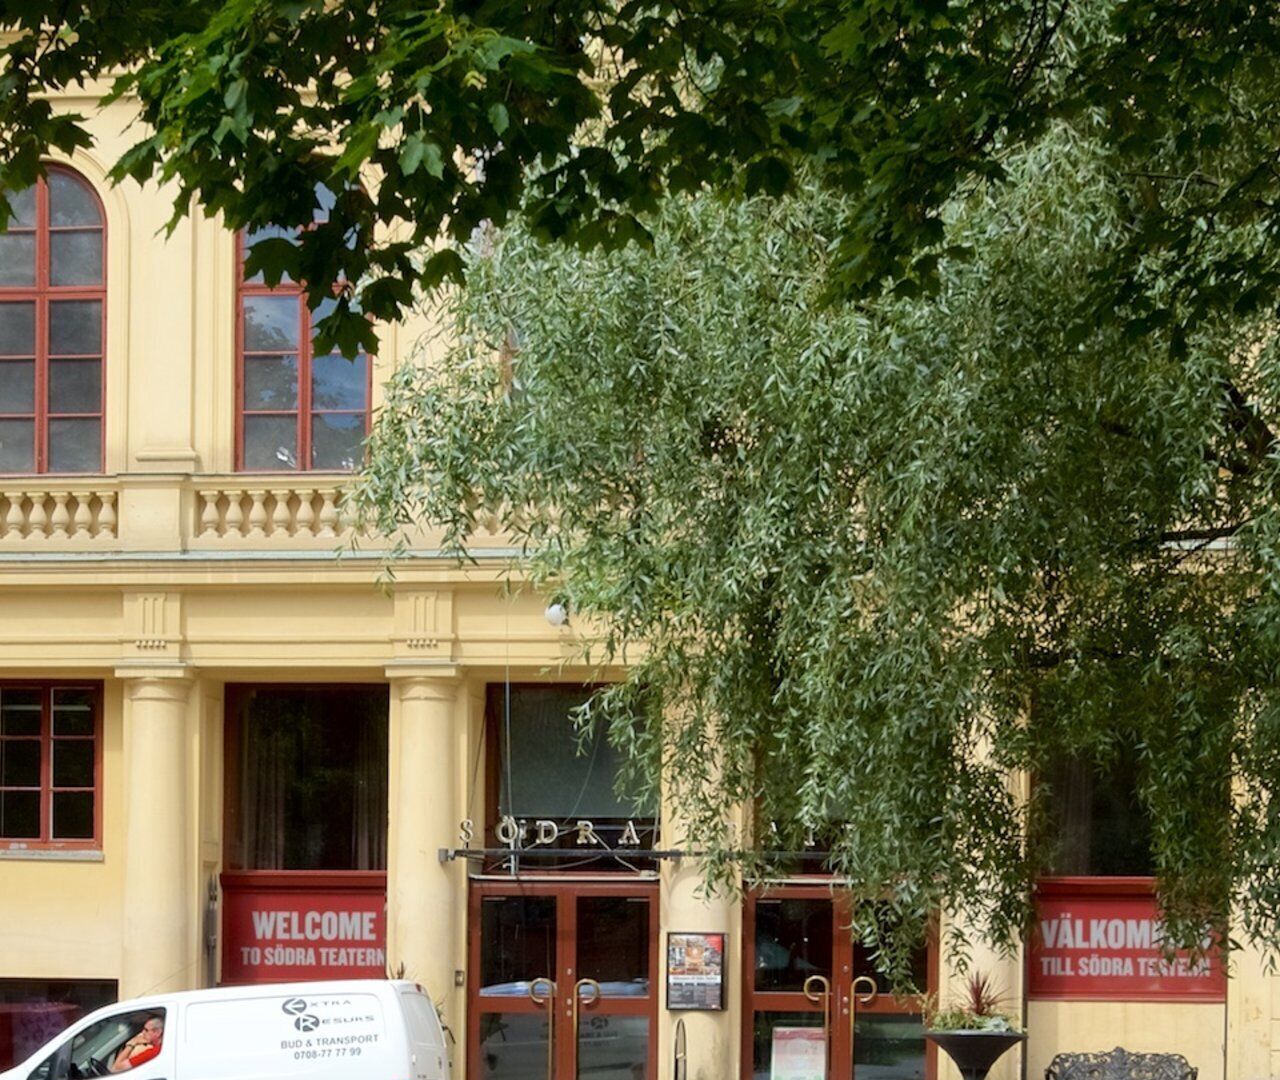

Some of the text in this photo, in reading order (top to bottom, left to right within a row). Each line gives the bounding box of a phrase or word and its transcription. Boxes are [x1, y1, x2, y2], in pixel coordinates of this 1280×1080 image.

[459, 815, 641, 846] SÖDRA
[252, 910, 377, 941] WELCOME
[1040, 912, 1212, 950] VÄLKOM
[241, 944, 385, 967] TO SÖDRA TEATERN
[1040, 956, 1074, 977] TILL
[1078, 953, 1134, 977] SÖDRA
[280, 1034, 379, 1049] BUD & TRANSPORT
[293, 1049, 332, 1060] 0708-77
[335, 1048, 346, 1056] 77
